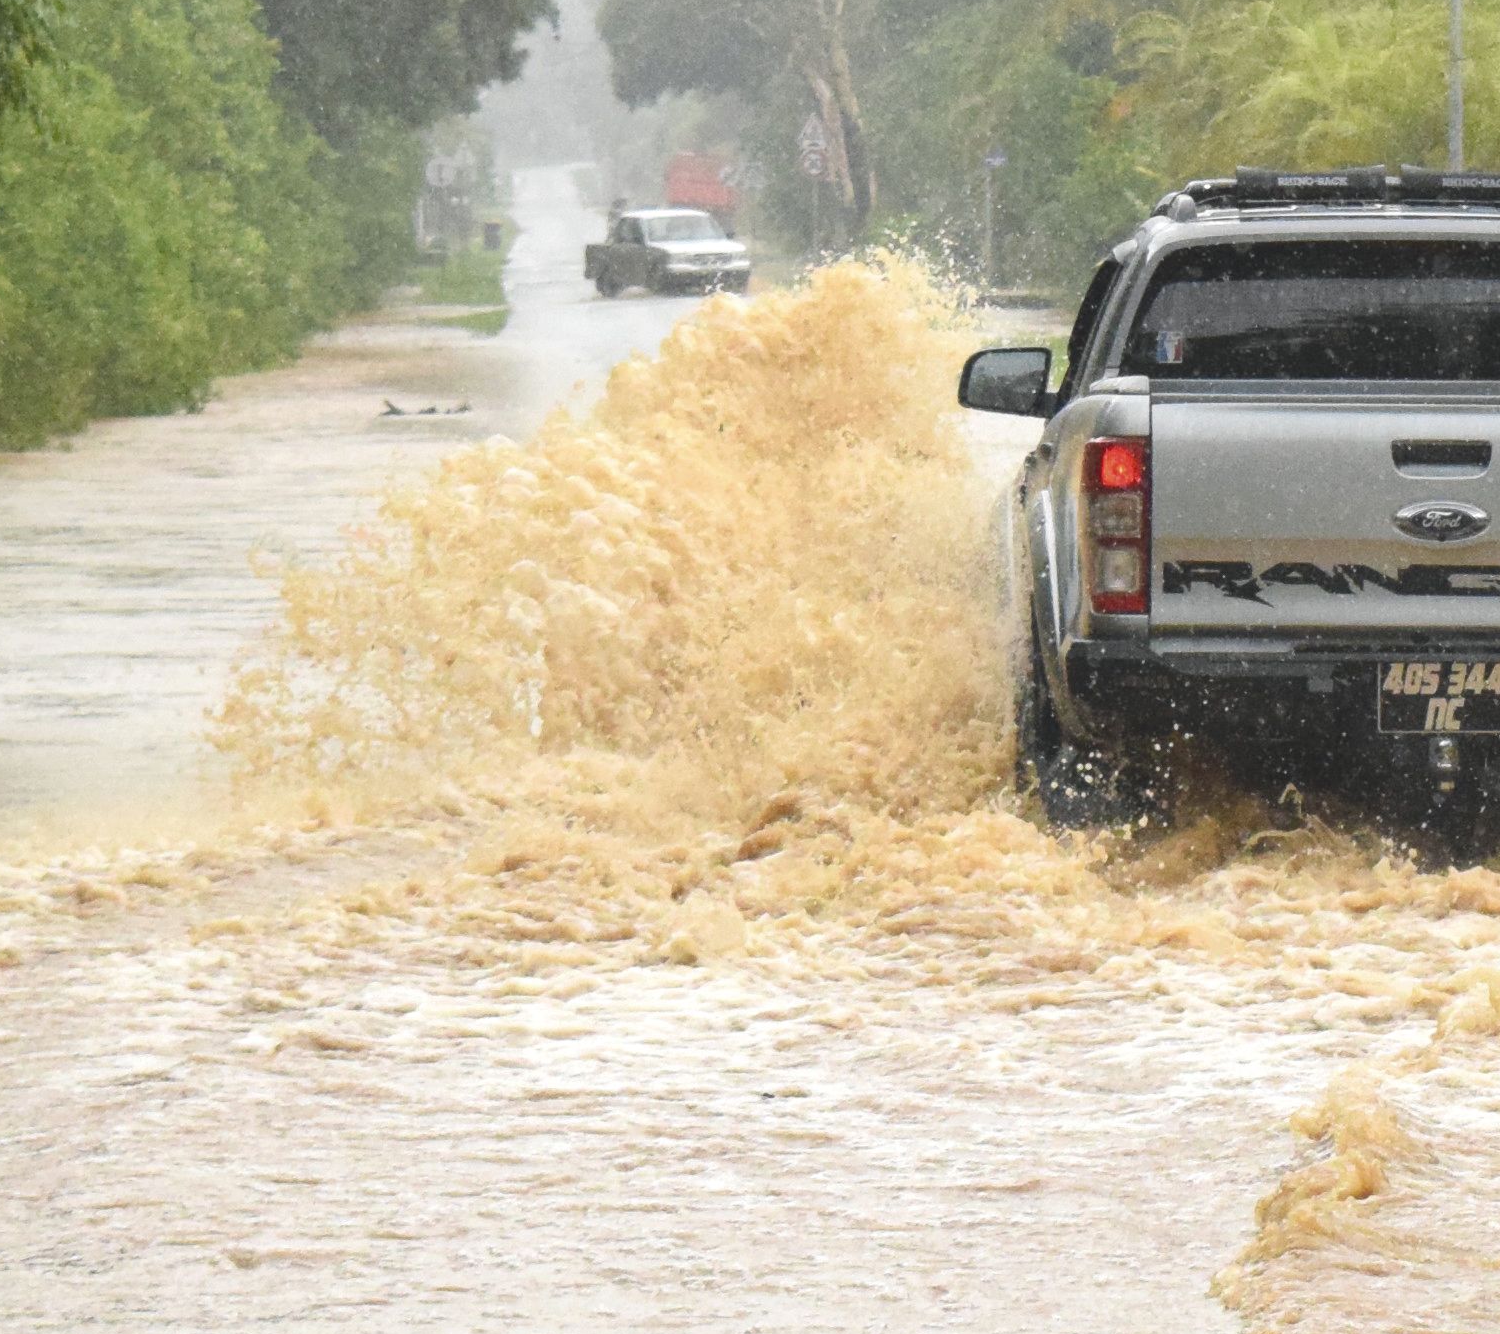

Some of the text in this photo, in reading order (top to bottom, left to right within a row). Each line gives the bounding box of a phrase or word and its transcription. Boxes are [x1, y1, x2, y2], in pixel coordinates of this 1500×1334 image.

[1422, 510, 1462, 528] Ford
[1383, 662, 1441, 695] 405
[1424, 697, 1466, 731] NC
